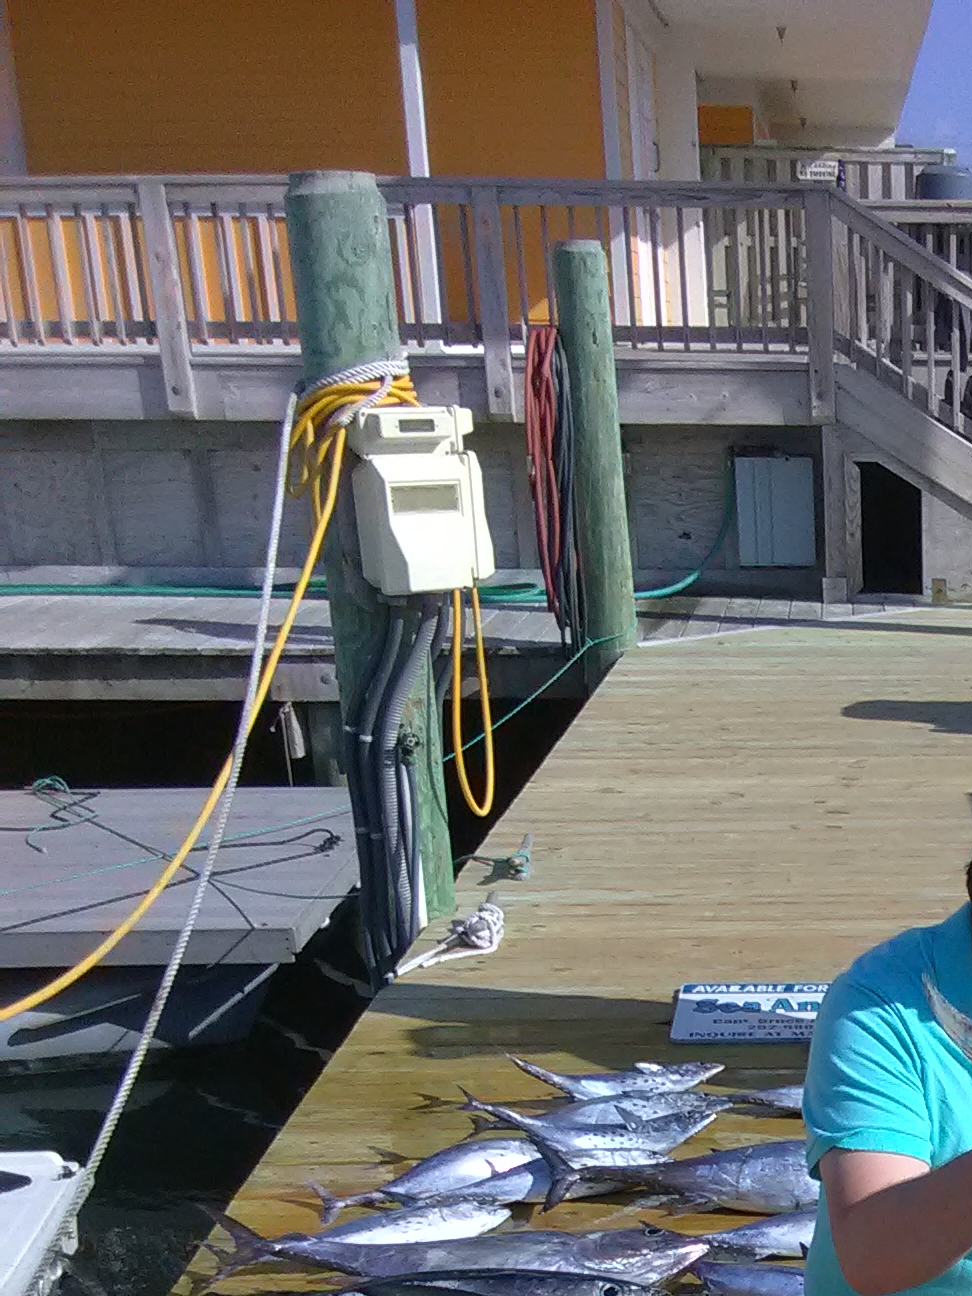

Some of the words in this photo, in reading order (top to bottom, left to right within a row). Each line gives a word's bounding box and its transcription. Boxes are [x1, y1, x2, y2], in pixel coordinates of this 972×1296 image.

[692, 984, 785, 993] AVAILABLE
[793, 984, 829, 993] FOR
[692, 999, 761, 1014] Sea
[769, 997, 820, 1013] An
